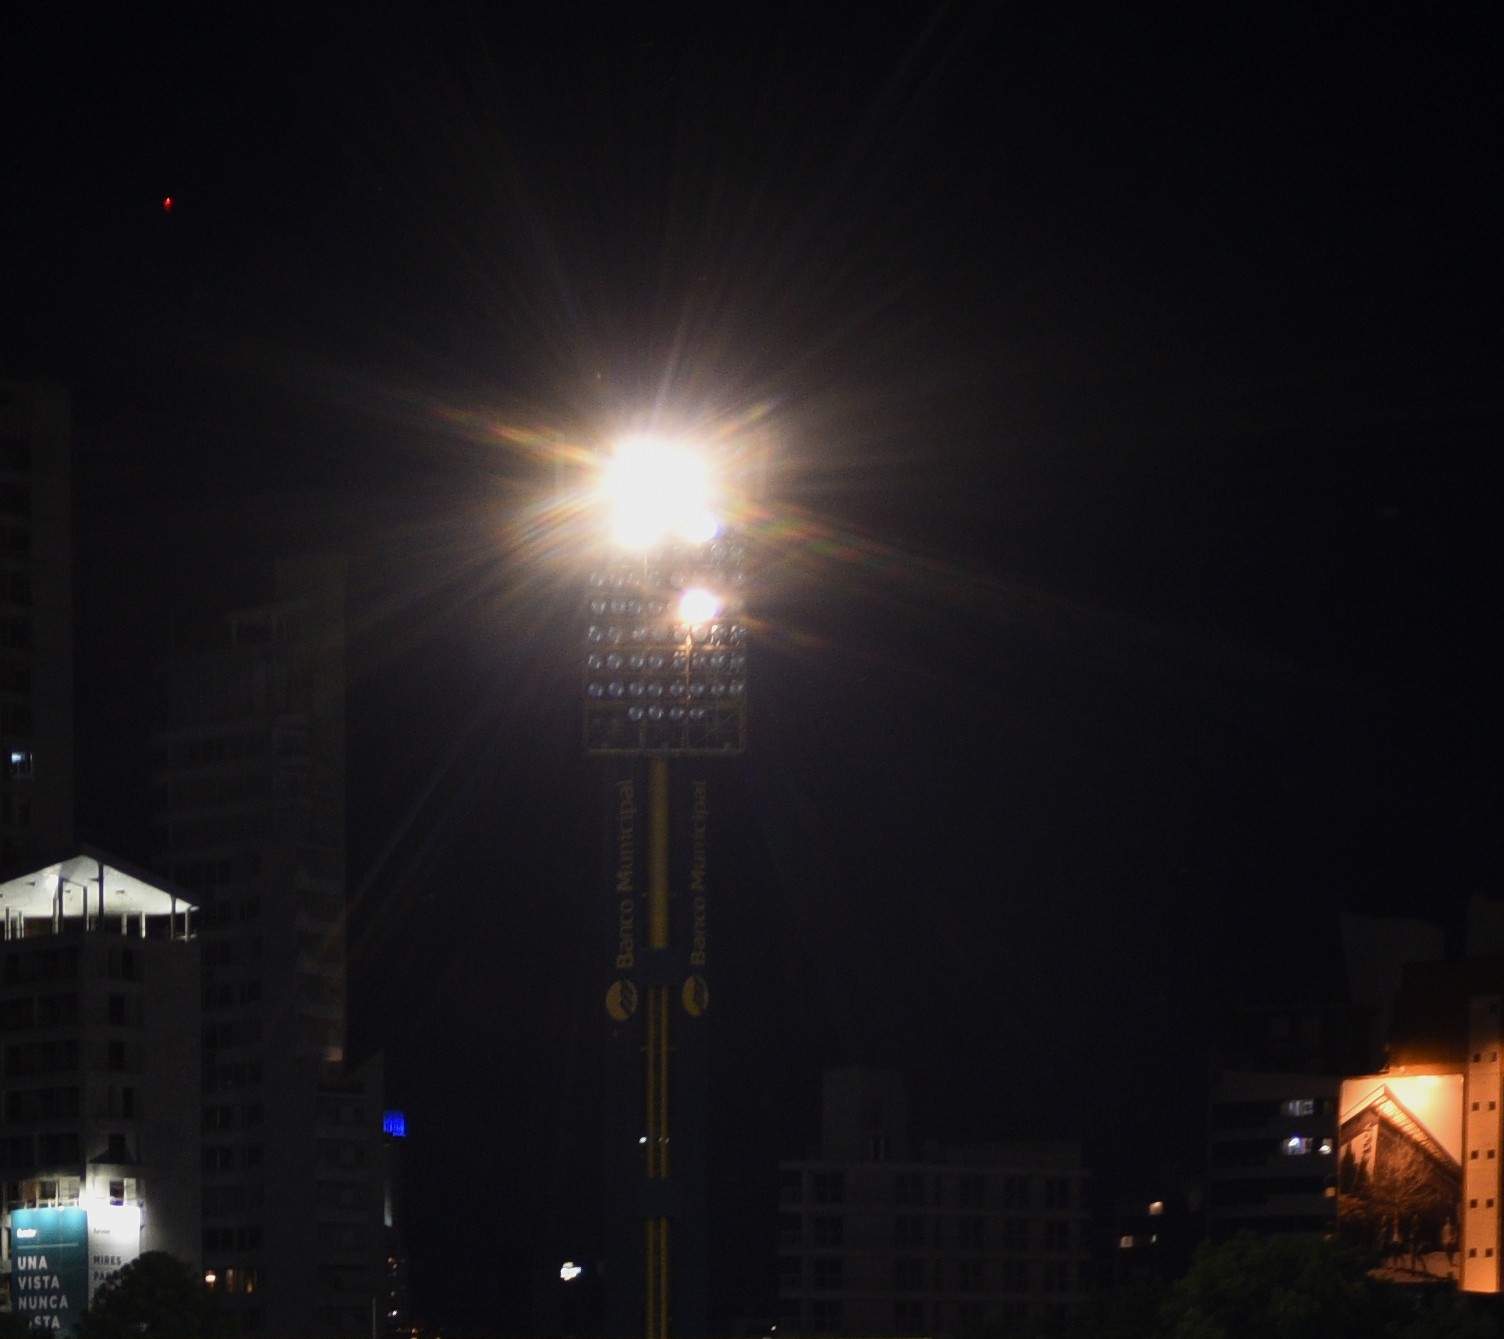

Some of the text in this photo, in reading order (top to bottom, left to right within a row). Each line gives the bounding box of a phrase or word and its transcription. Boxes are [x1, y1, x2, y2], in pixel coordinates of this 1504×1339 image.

[617, 780, 635, 968] Banco Municipal
[18, 1255, 48, 1271] UNA
[18, 1275, 60, 1290] VISTA
[18, 1295, 68, 1310] NUNCA
